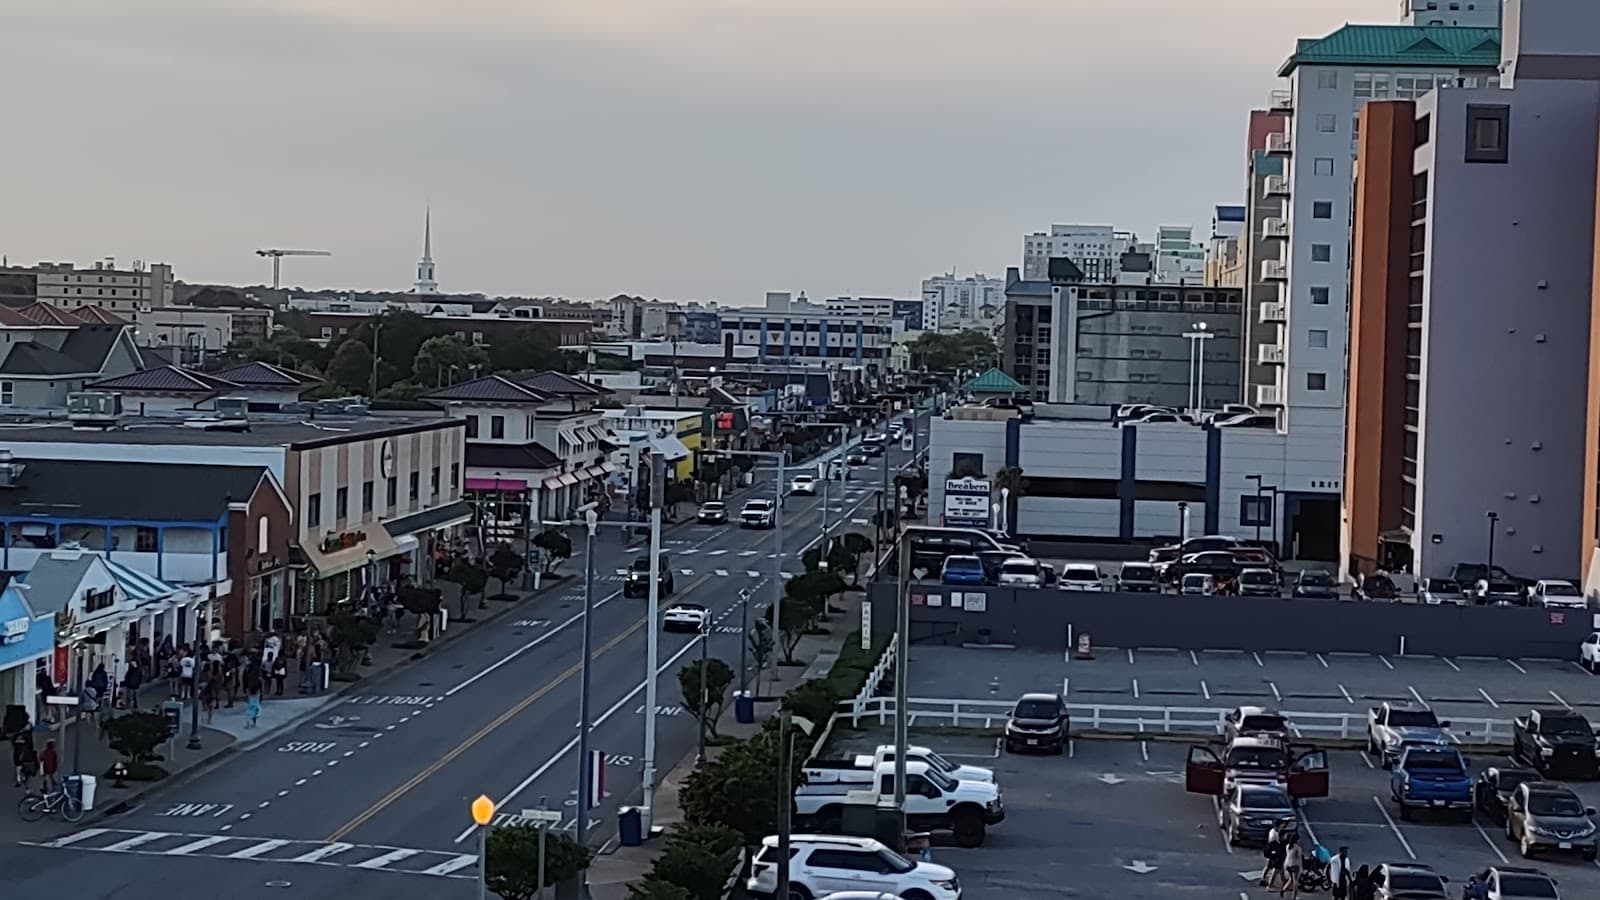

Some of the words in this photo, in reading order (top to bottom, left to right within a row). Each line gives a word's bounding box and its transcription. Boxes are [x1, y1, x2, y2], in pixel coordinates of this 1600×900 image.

[862, 602, 870, 648] PARKING
[278, 742, 337, 752] BUS
[603, 754, 634, 766] US
[153, 803, 234, 817] LANE
